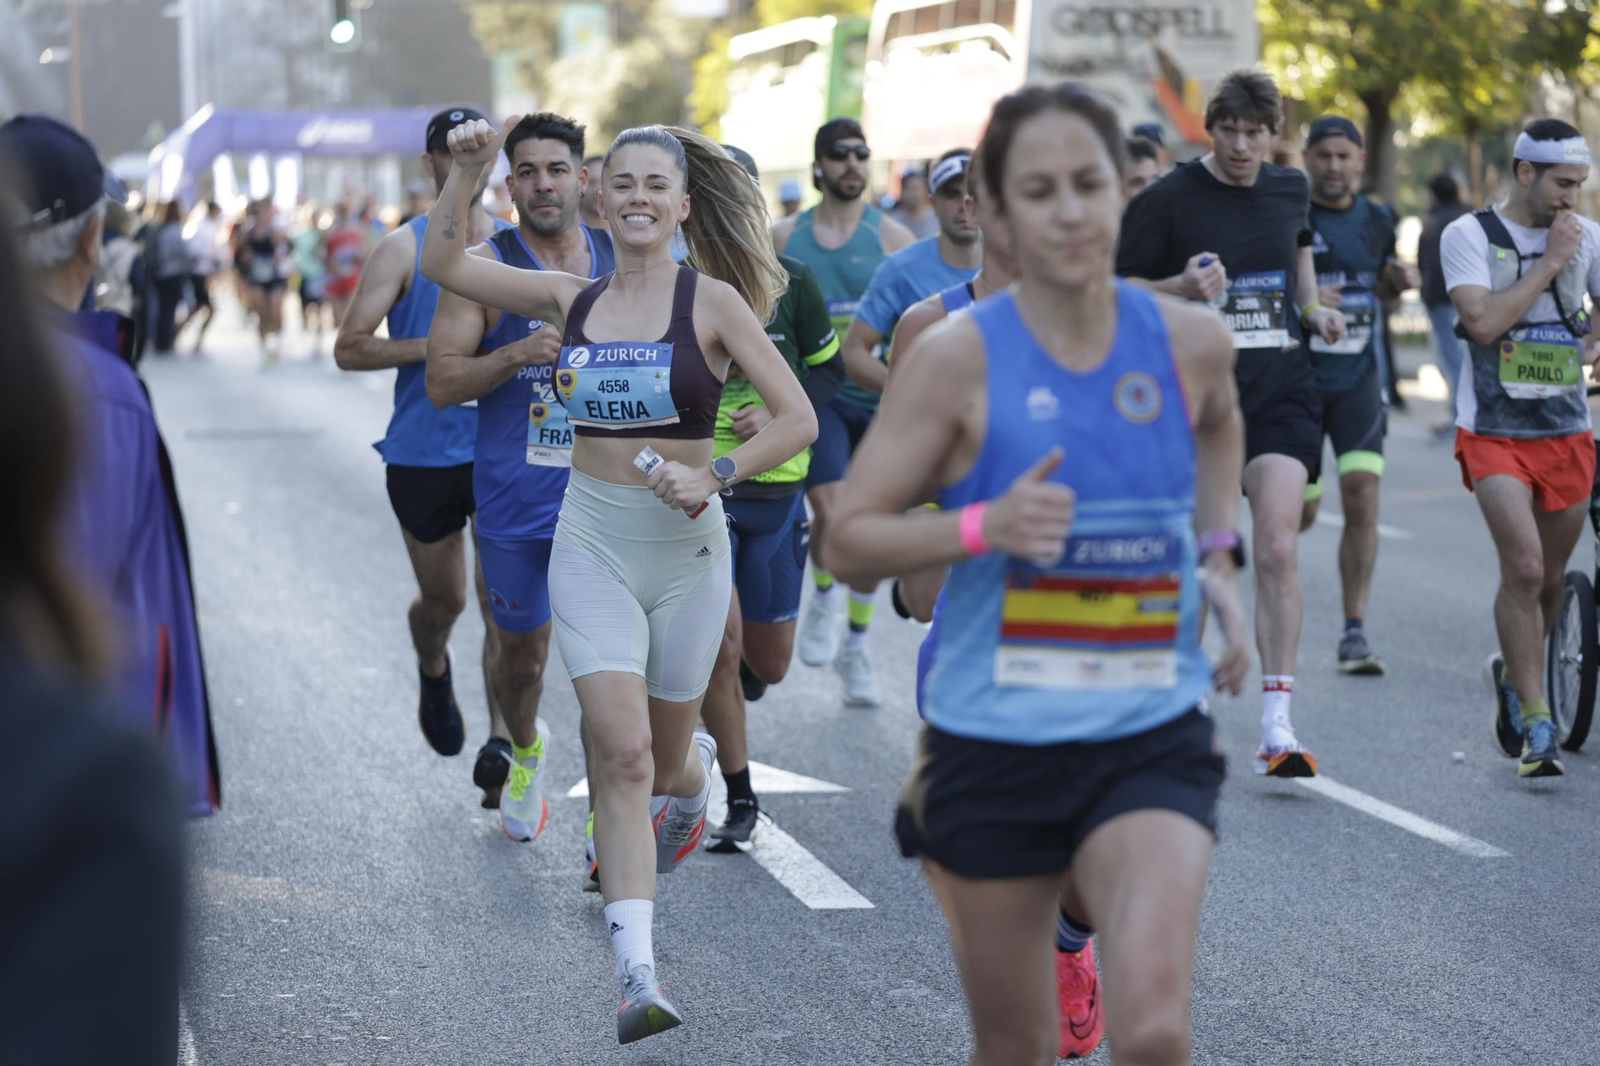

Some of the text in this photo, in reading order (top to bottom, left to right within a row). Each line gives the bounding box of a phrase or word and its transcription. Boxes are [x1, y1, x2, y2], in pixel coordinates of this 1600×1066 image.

[1234, 275, 1282, 289] ZURICH
[1531, 329, 1573, 342] ZURICH
[595, 348, 658, 362] ZURICH
[1517, 365, 1564, 382] PAULO
[598, 380, 630, 394] 4558
[585, 400, 651, 420] ELENA
[1074, 538, 1167, 564] ZURICH
